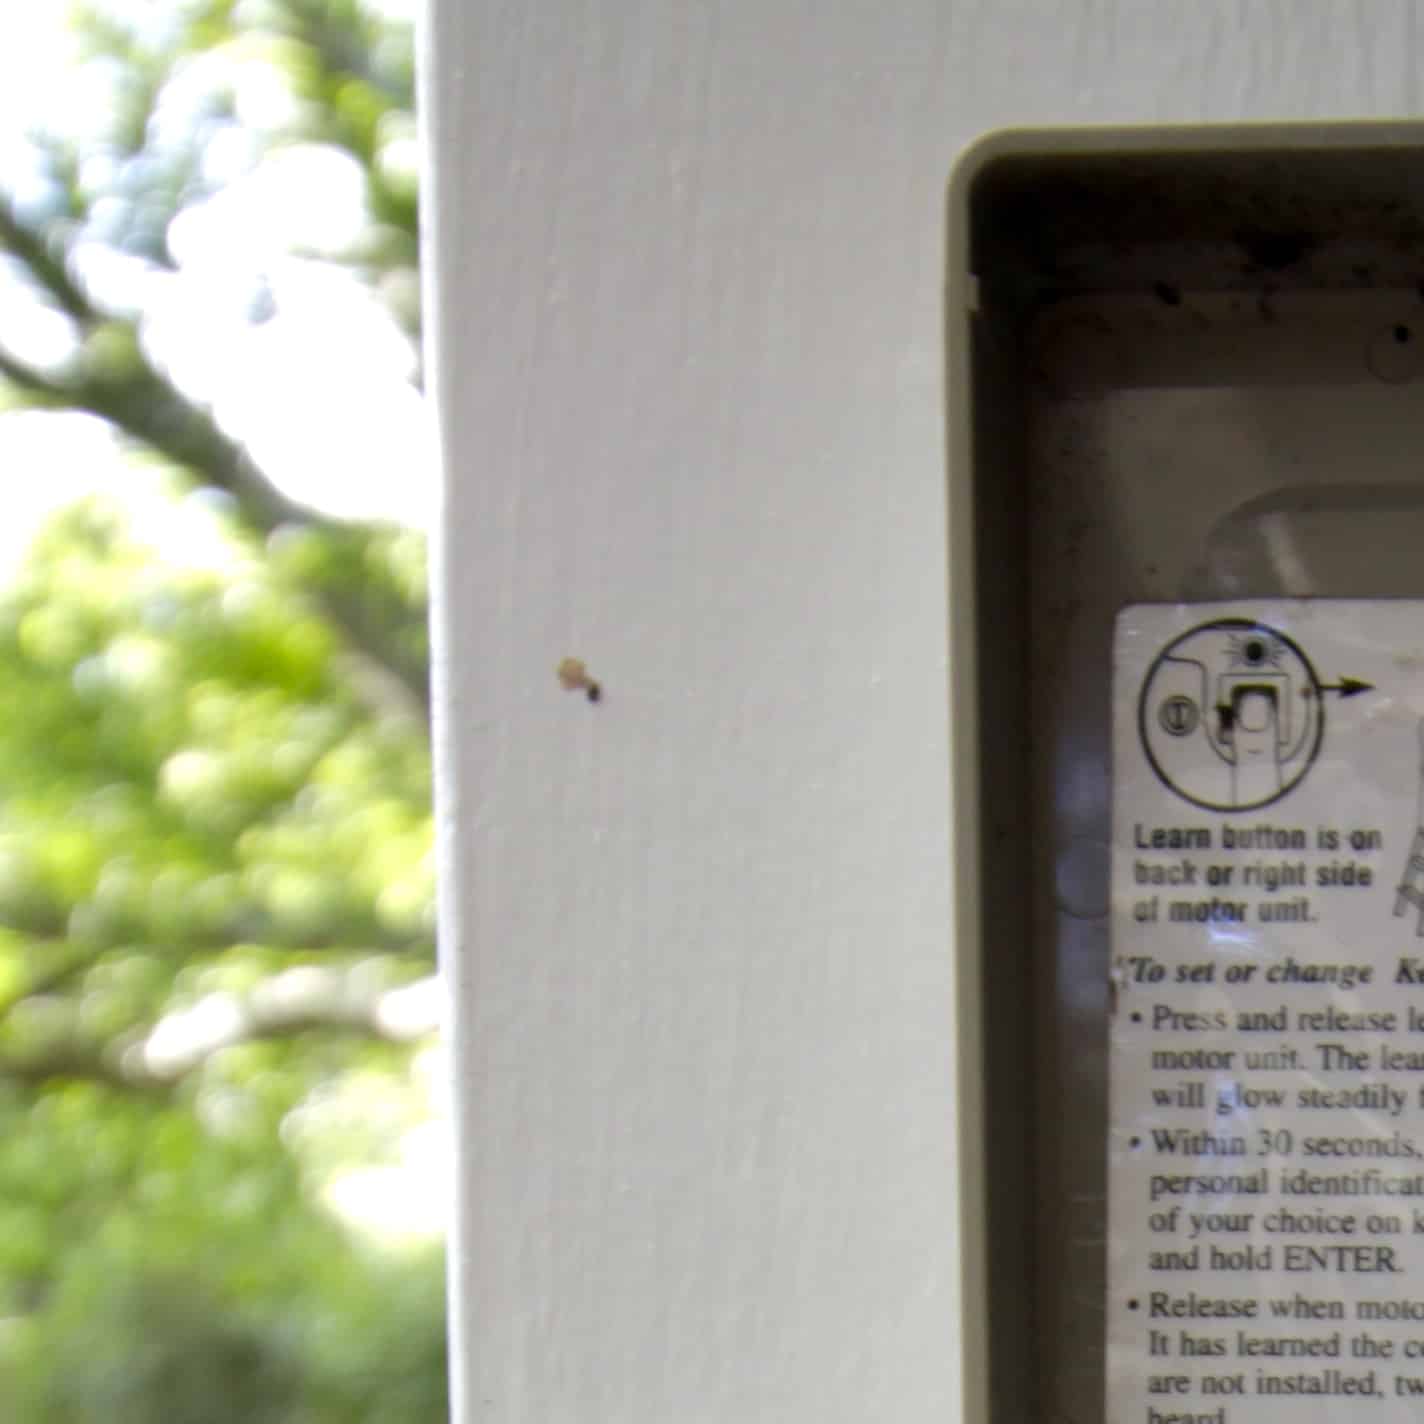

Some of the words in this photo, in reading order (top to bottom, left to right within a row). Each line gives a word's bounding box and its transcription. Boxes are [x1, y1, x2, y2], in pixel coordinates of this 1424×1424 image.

[1135, 825, 1209, 851] Learn
[1223, 825, 1307, 852] button
[1318, 825, 1338, 852] is
[1350, 829, 1380, 852] on
[1135, 860, 1197, 887] back
[1206, 864, 1233, 887] or
[1244, 861, 1306, 893] right
[1316, 861, 1372, 888] side
[1167, 898, 1248, 924] motor
[1259, 898, 1317, 925] unit.
[1129, 956, 1163, 984] To
[1175, 959, 1214, 984] set
[1225, 963, 1255, 984] or
[1267, 957, 1373, 990] change
[1152, 1005, 1226, 1032] Press
[1238, 1005, 1286, 1033] and
[1297, 1006, 1396, 1033] release
[1152, 1046, 1233, 1071] motor
[1318, 1044, 1369, 1072] The
[1152, 1081, 1205, 1109] will
[1297, 1083, 1403, 1116] steadily
[1152, 1129, 1246, 1157] Within
[1257, 1130, 1292, 1158] 30
[1304, 1130, 1423, 1161] seconds,
[1150, 1168, 1269, 1201] personal
[1149, 1206, 1178, 1234] of
[1188, 1213, 1253, 1241] your
[1264, 1207, 1355, 1235] choice
[1366, 1215, 1400, 1235] on
[1149, 1244, 1198, 1272] and
[1210, 1245, 1271, 1273] hold
[1284, 1246, 1403, 1274] ENTER.
[1148, 1292, 1258, 1320] Release
[1269, 1293, 1345, 1321] when
[1148, 1330, 1170, 1357] It
[1180, 1330, 1225, 1358] has
[1237, 1331, 1339, 1359] learned
[1352, 1332, 1393, 1360] the
[1148, 1374, 1189, 1395] are
[1202, 1371, 1246, 1396] not
[1256, 1369, 1382, 1400] installed,
